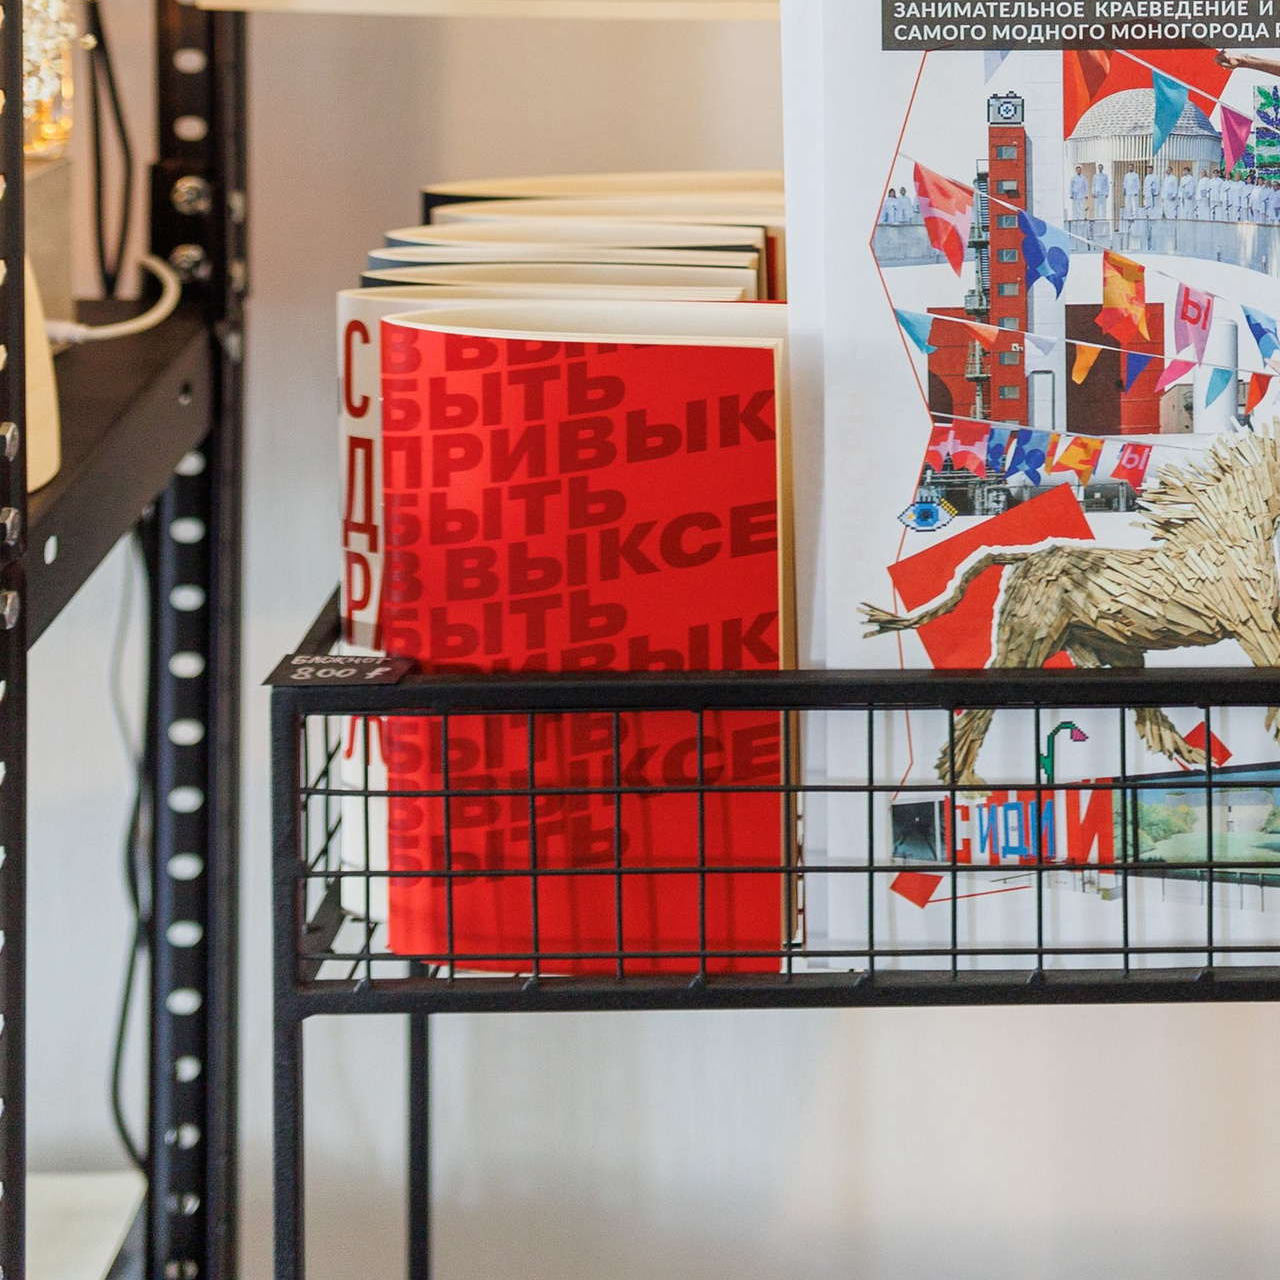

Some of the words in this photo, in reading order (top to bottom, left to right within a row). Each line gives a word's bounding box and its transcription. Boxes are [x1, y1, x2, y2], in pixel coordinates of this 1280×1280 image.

[893, 1, 1085, 19] ЗАНИМАТЕЛЬНОЕ
[1095, 0, 1249, 21] КРАЕВЕДЕНИЕ
[1259, 1, 1274, 17] И
[893, 24, 988, 41] САМОГО
[993, 23, 1106, 43] МОДНОГО
[1111, 22, 1270, 42] МОНОГОРОДА
[383, 361, 626, 432] БЫТЬ
[383, 389, 776, 489] ПРИВЫК
[384, 476, 627, 546] БЫТЬ
[386, 550, 423, 603] В
[445, 500, 777, 601] ВЫКСЕ
[386, 589, 628, 660] БЫТЬ
[290, 667, 357, 679] 800
[389, 814, 629, 888] БЫТЬ
